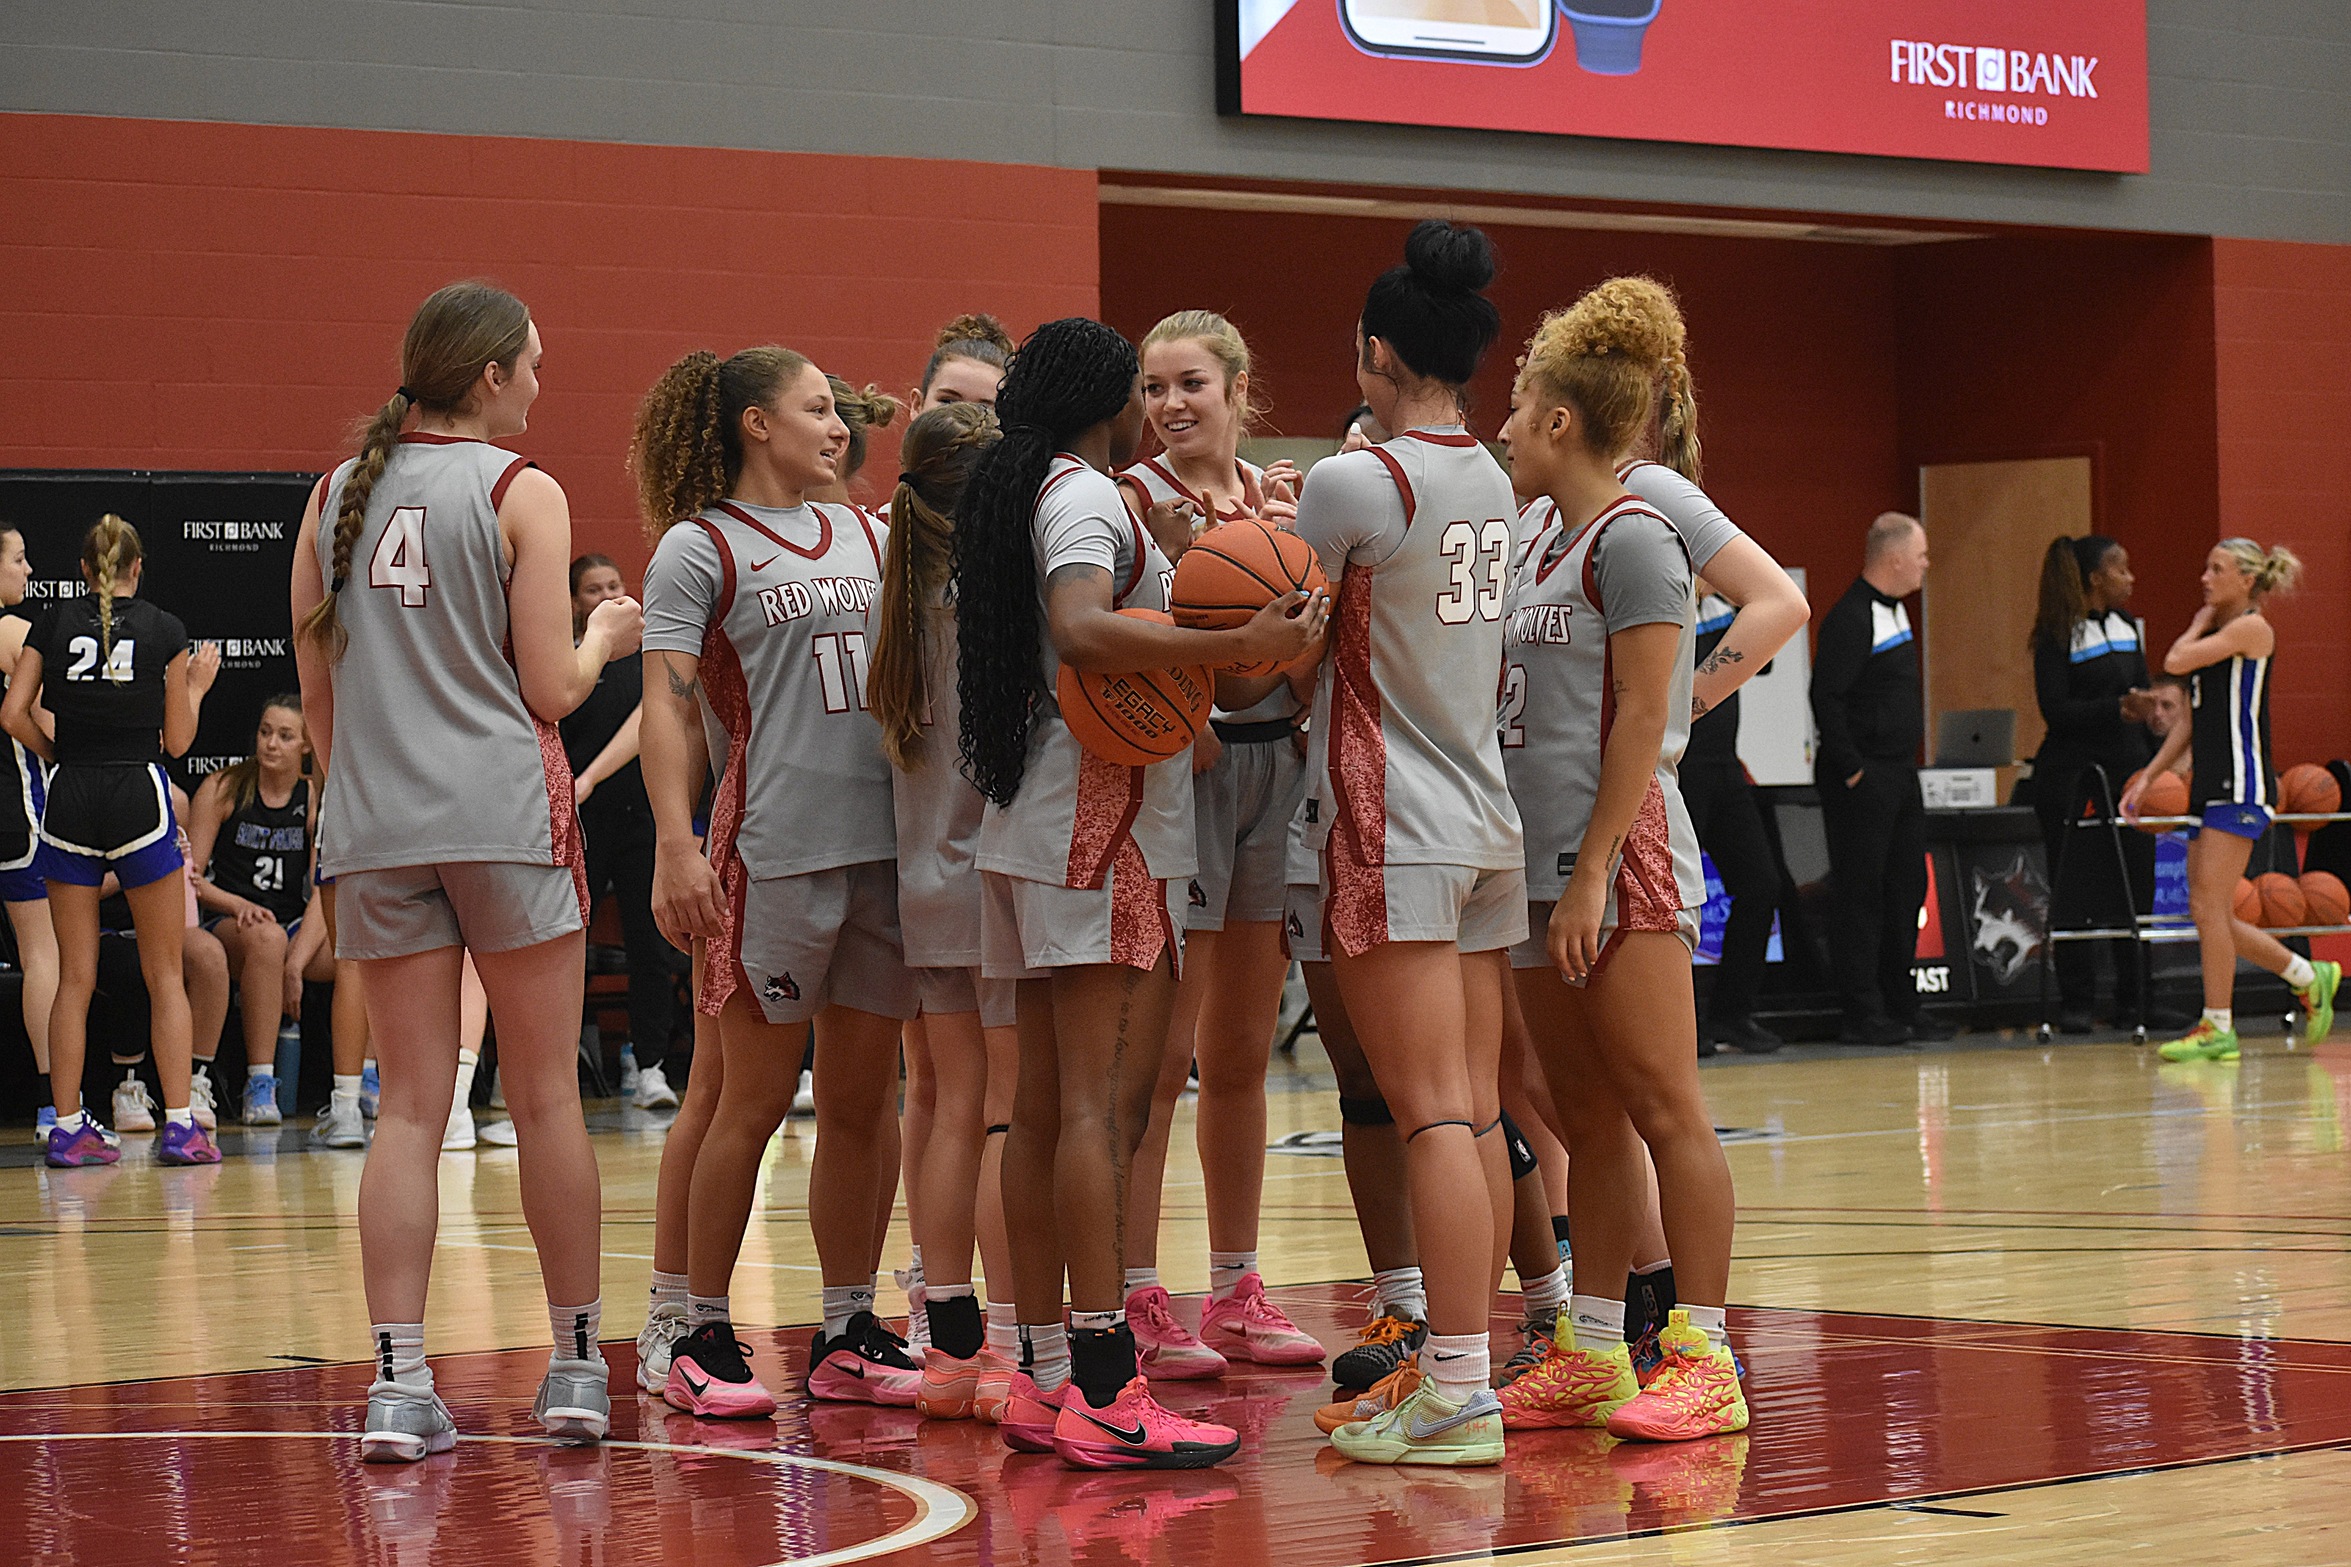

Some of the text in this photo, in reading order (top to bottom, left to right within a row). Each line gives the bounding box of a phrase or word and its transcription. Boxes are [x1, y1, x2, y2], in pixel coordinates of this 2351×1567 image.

[1890, 39, 2098, 98] FIRST BANK
[1944, 99, 2048, 126] RICHMOND
[183, 521, 284, 539] FIRST BANK
[209, 542, 259, 552] RICHMOND
[369, 506, 431, 608] 4
[1436, 518, 1511, 626] 33
[25, 580, 57, 598] IRST
[757, 581, 813, 628] RED
[1512, 603, 1573, 648] WOLVES
[66, 635, 135, 681] 24
[243, 639, 286, 656] BANK
[812, 631, 873, 715] 11
[188, 756, 227, 774] FIRST
[252, 855, 284, 891] 21
[1910, 967, 1950, 992] AST
[1112, 1036, 1129, 1069] love
